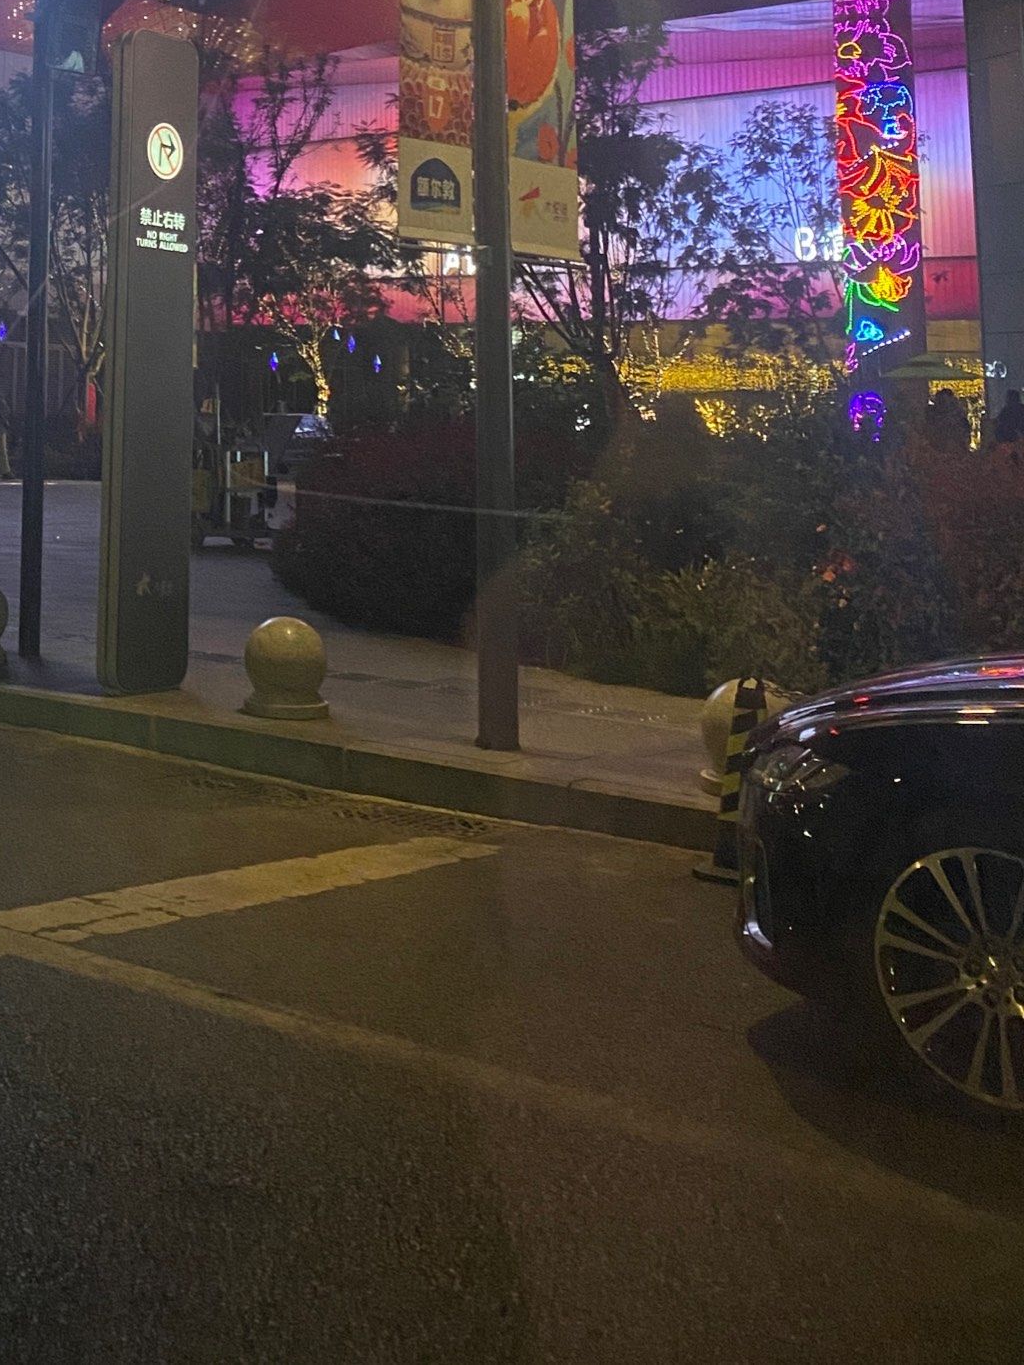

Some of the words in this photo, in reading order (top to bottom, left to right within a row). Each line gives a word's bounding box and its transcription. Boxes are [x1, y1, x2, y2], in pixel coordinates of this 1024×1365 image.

[139, 207, 186, 231] 禁止右转
[146, 230, 157, 239] NO
[159, 231, 178, 242] RIGHT
[136, 237, 157, 249] TURNS
[158, 240, 189, 253] ALLOWED
